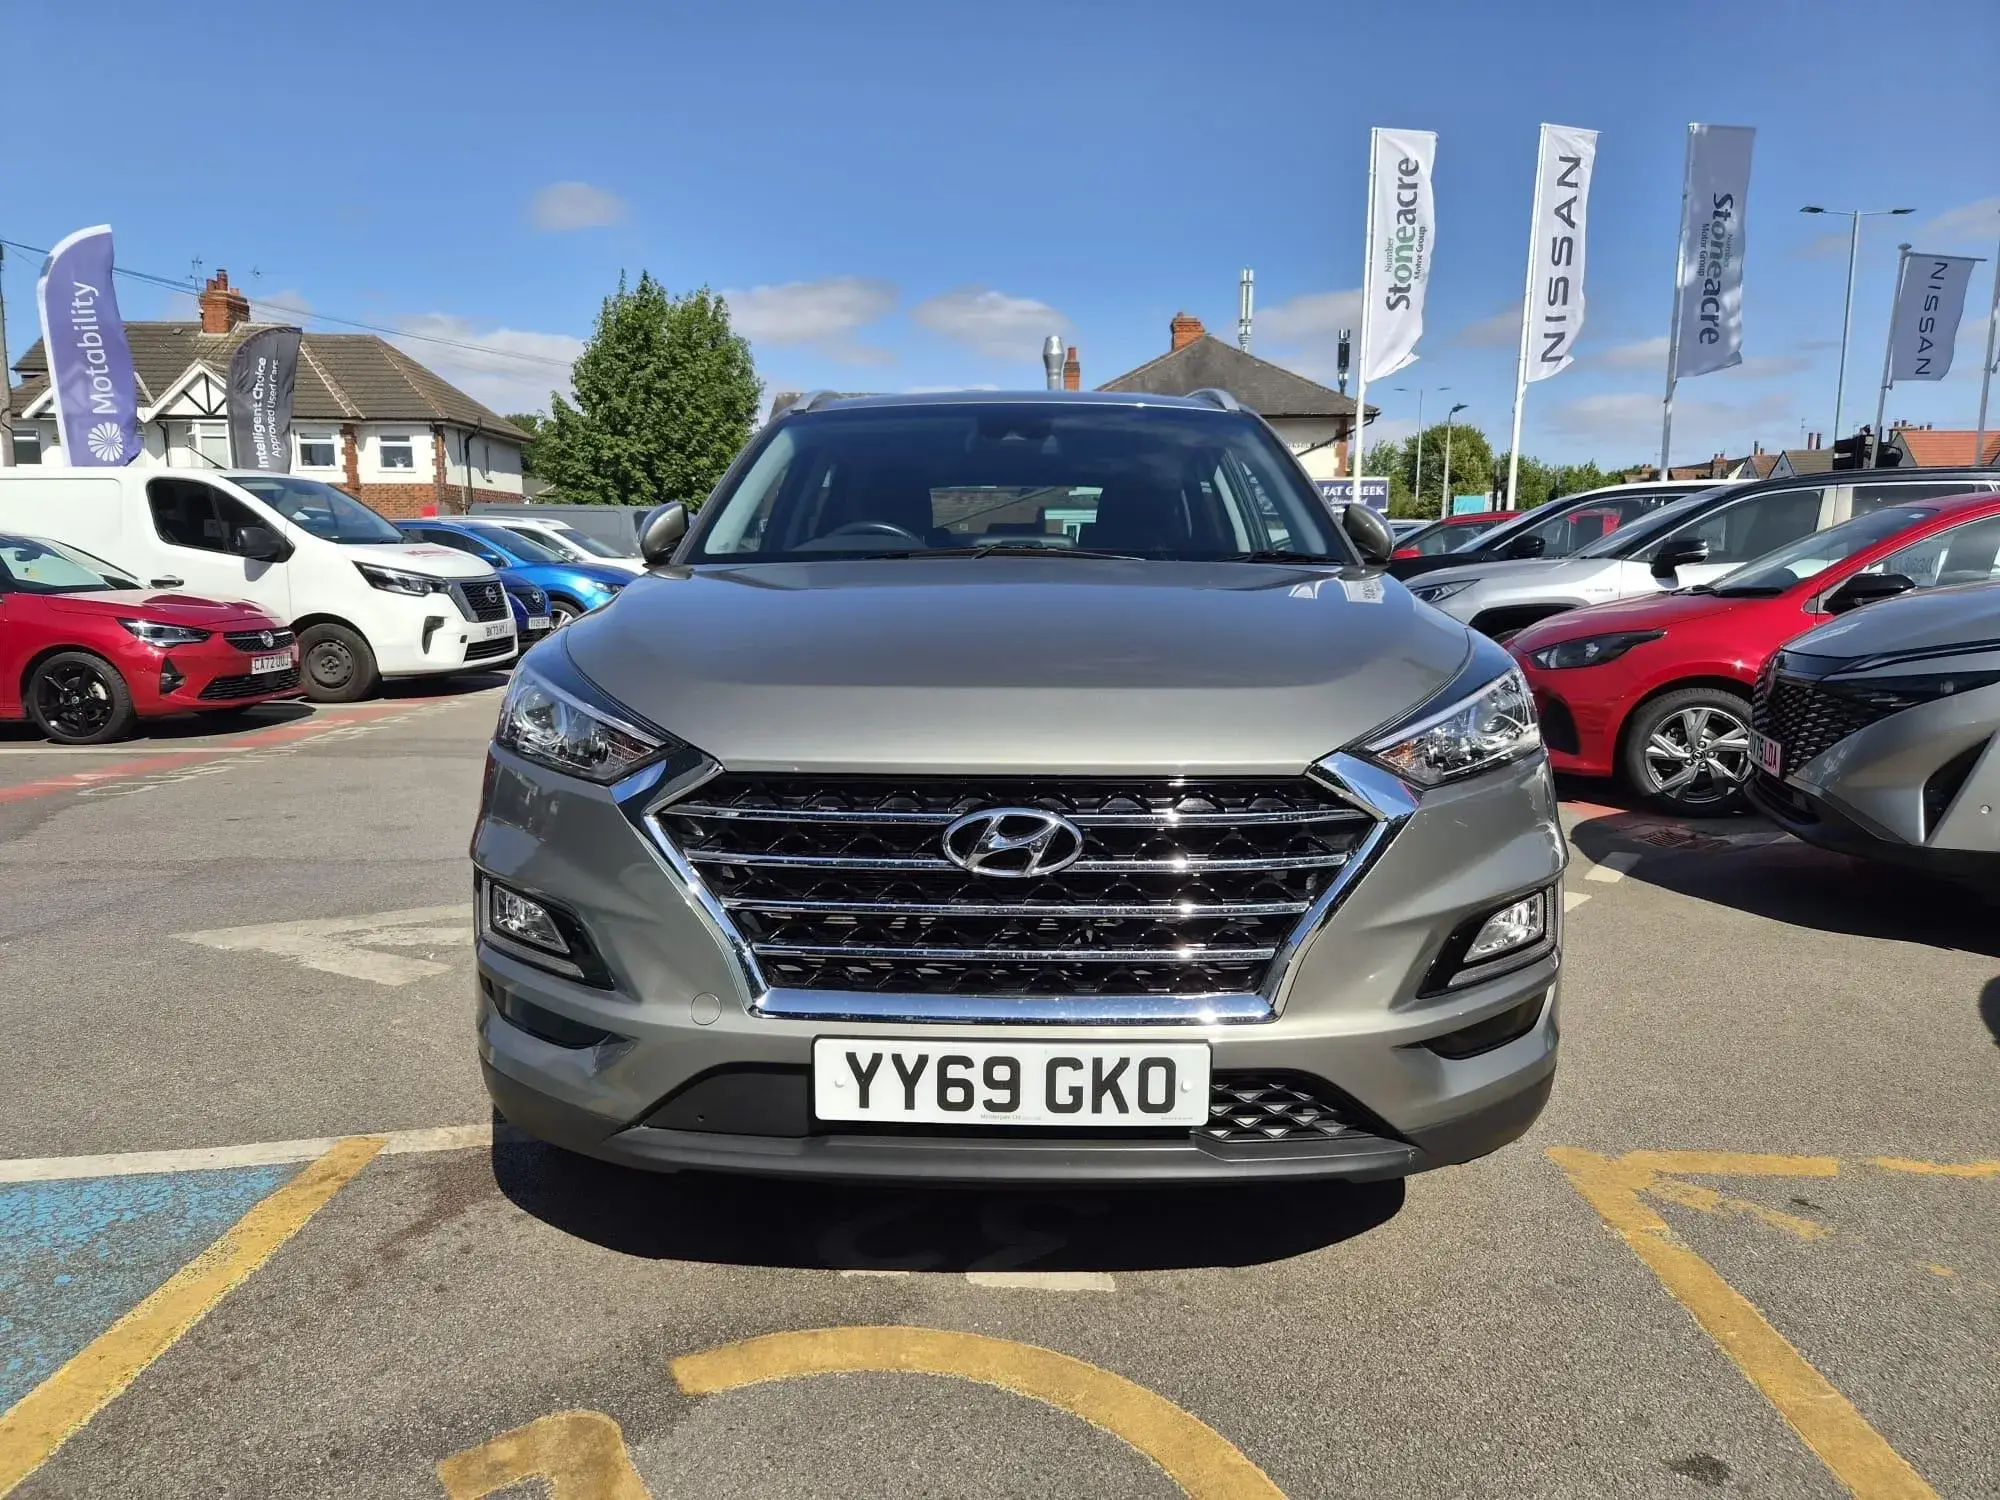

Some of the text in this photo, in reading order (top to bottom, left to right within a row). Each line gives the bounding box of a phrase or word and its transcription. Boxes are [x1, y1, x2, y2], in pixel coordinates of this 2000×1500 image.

[1384, 237, 1394, 273] Number
[1385, 157, 1419, 312] Stoneacre
[1414, 226, 1427, 280] Motor Group
[1540, 155, 1582, 363] NISSAN
[1697, 223, 1710, 277] Motor Group
[1698, 192, 1734, 345] Stoneacre
[71, 281, 117, 414] Motability
[1915, 262, 1948, 375] NISSAN
[252, 357, 269, 468] Intelligent Choice
[267, 360, 281, 458] Approved Used Cars
[1323, 486, 1385, 496] FAT GEEK
[845, 1051, 1176, 1114] YY69 GKO
